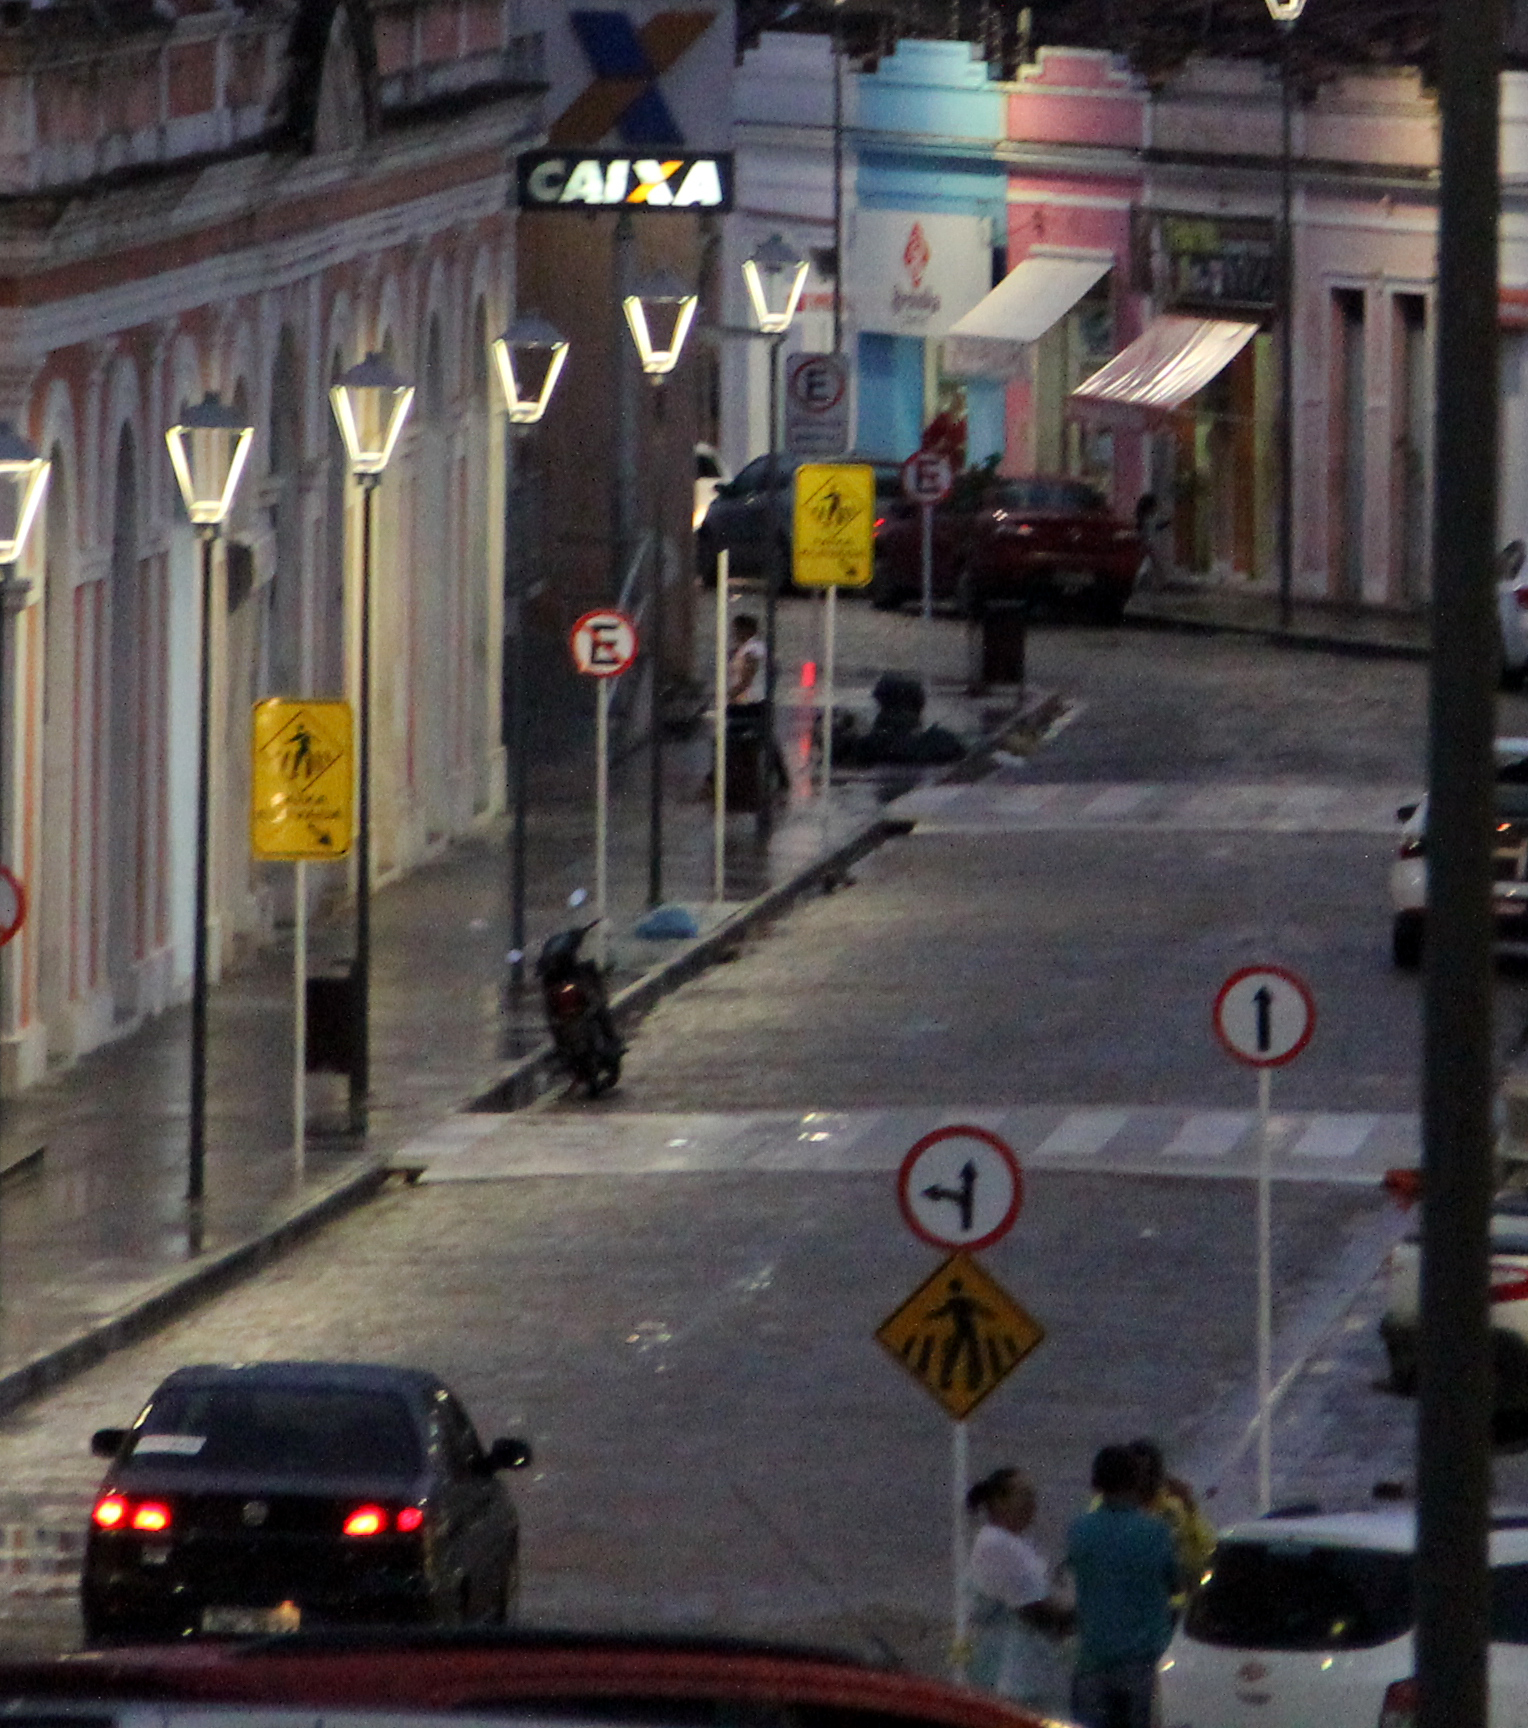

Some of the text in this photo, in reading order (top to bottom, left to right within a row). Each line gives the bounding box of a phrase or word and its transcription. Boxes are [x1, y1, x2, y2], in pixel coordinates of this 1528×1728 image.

[528, 158, 722, 206] CAIXA
[806, 369, 830, 401] E
[591, 623, 620, 664] E
